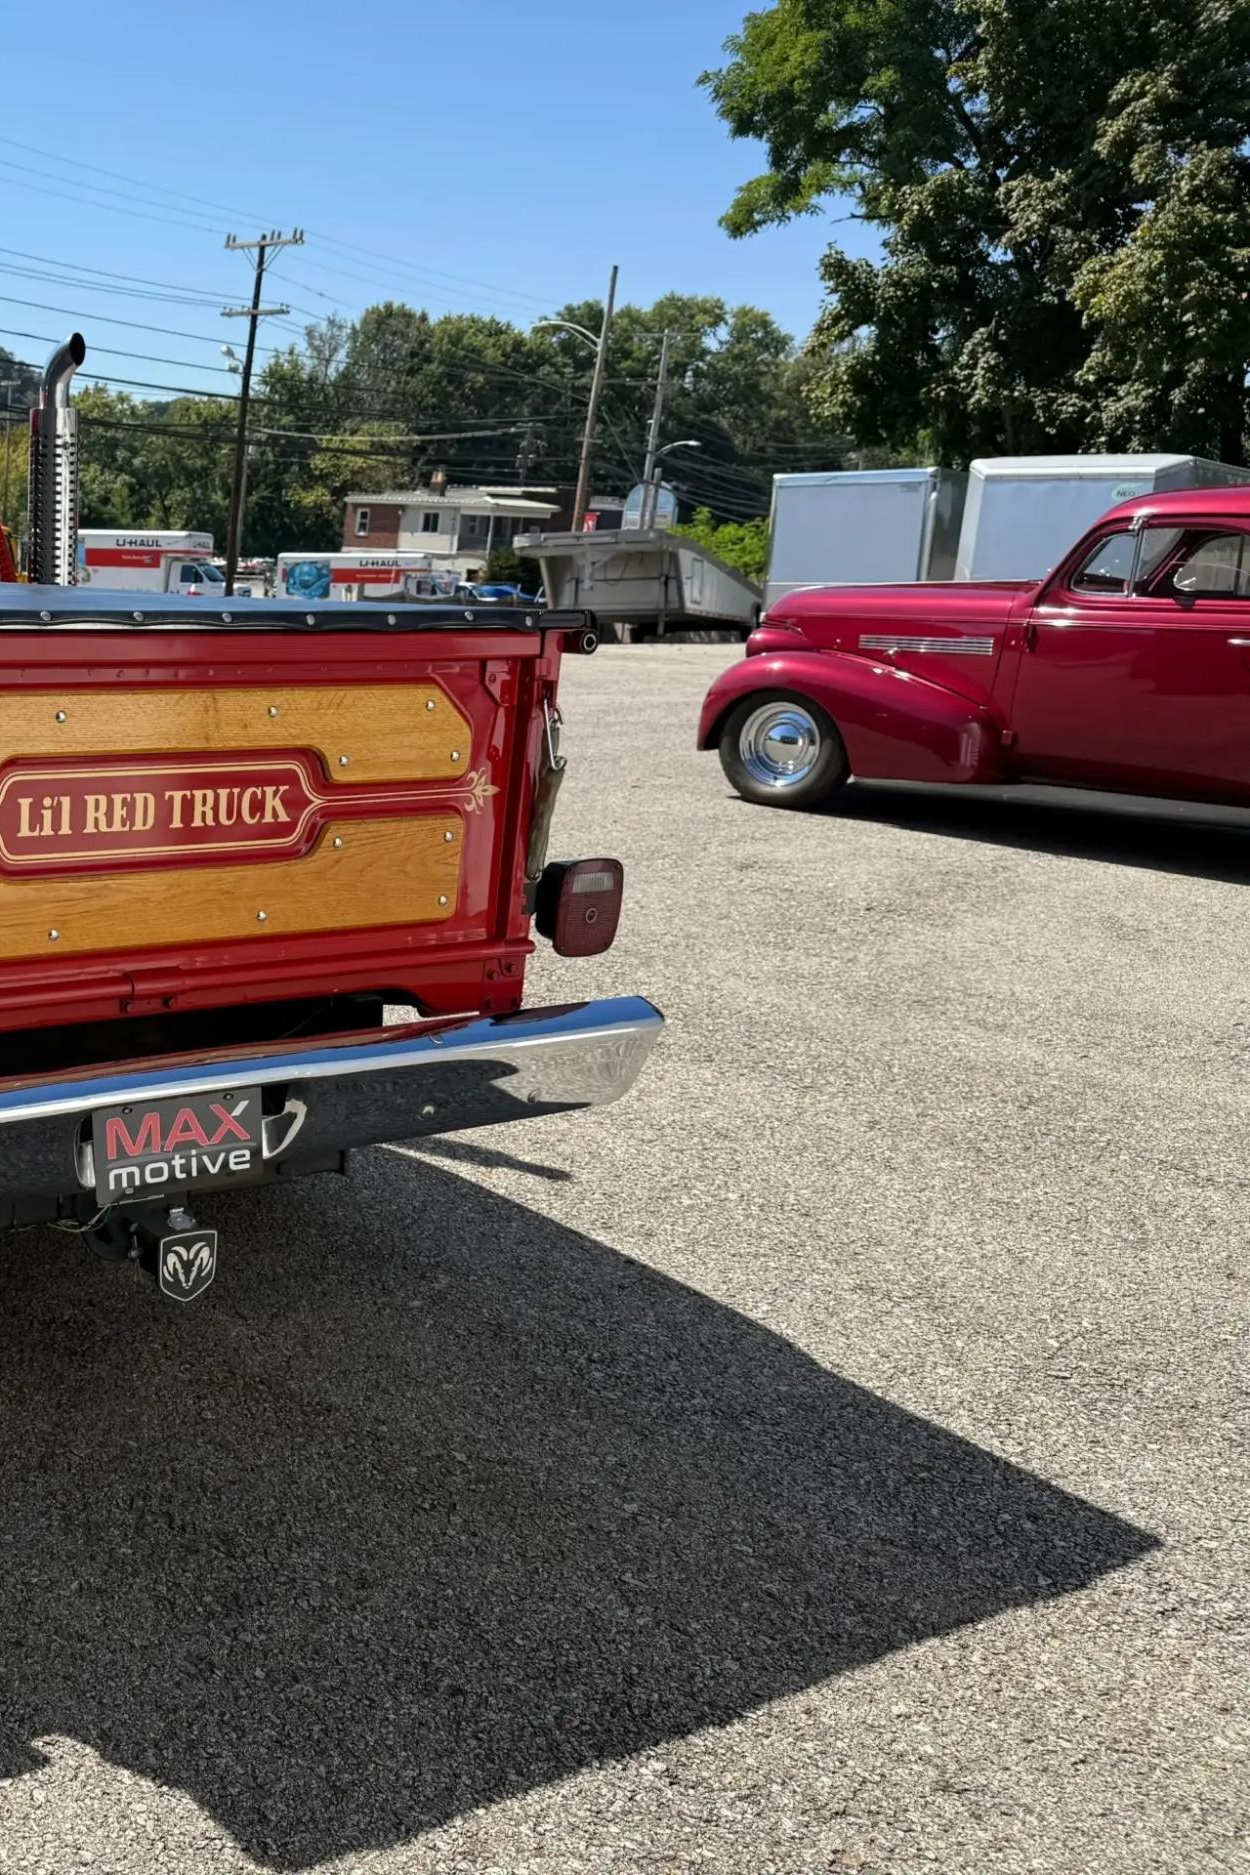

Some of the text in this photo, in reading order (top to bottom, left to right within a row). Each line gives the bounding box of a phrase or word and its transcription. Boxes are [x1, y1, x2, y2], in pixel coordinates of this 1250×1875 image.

[116, 538, 162, 548] U-HAUL
[359, 559, 401, 568] U-HAUL
[82, 792, 155, 834] RED
[164, 785, 292, 829] TRUCK
[105, 1100, 251, 1161] MAX
[108, 1149, 251, 1191] motive
